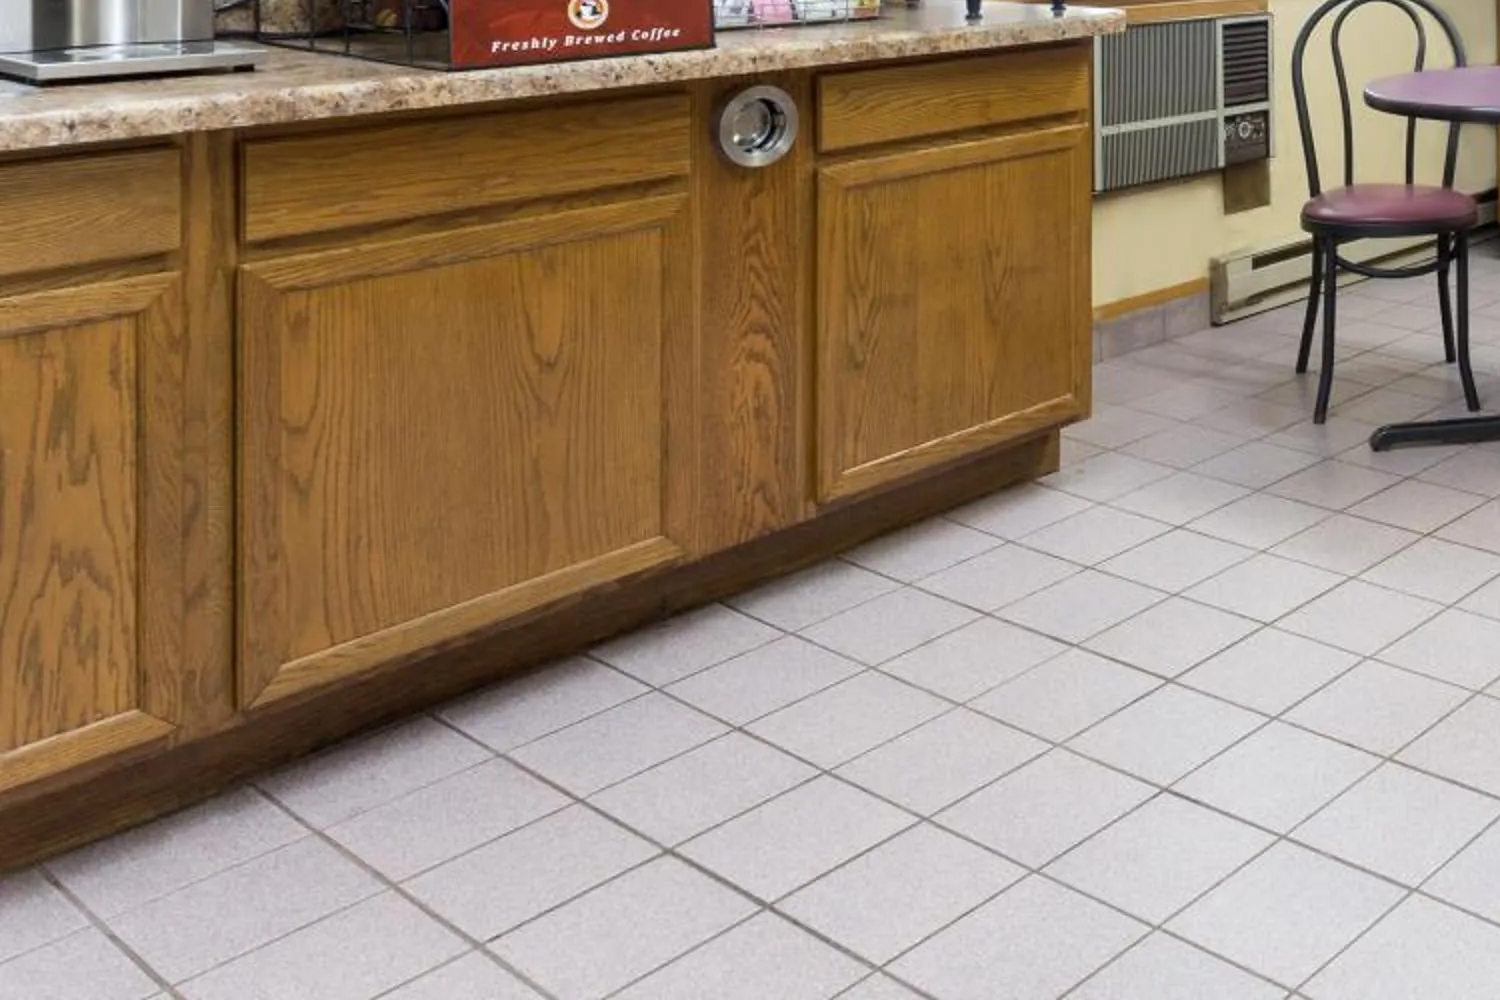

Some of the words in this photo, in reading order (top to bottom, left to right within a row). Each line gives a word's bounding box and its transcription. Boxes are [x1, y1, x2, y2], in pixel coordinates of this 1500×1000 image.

[490, 36, 558, 53] Freshly
[564, 29, 626, 48] Brewed
[631, 27, 681, 42] Coffee
